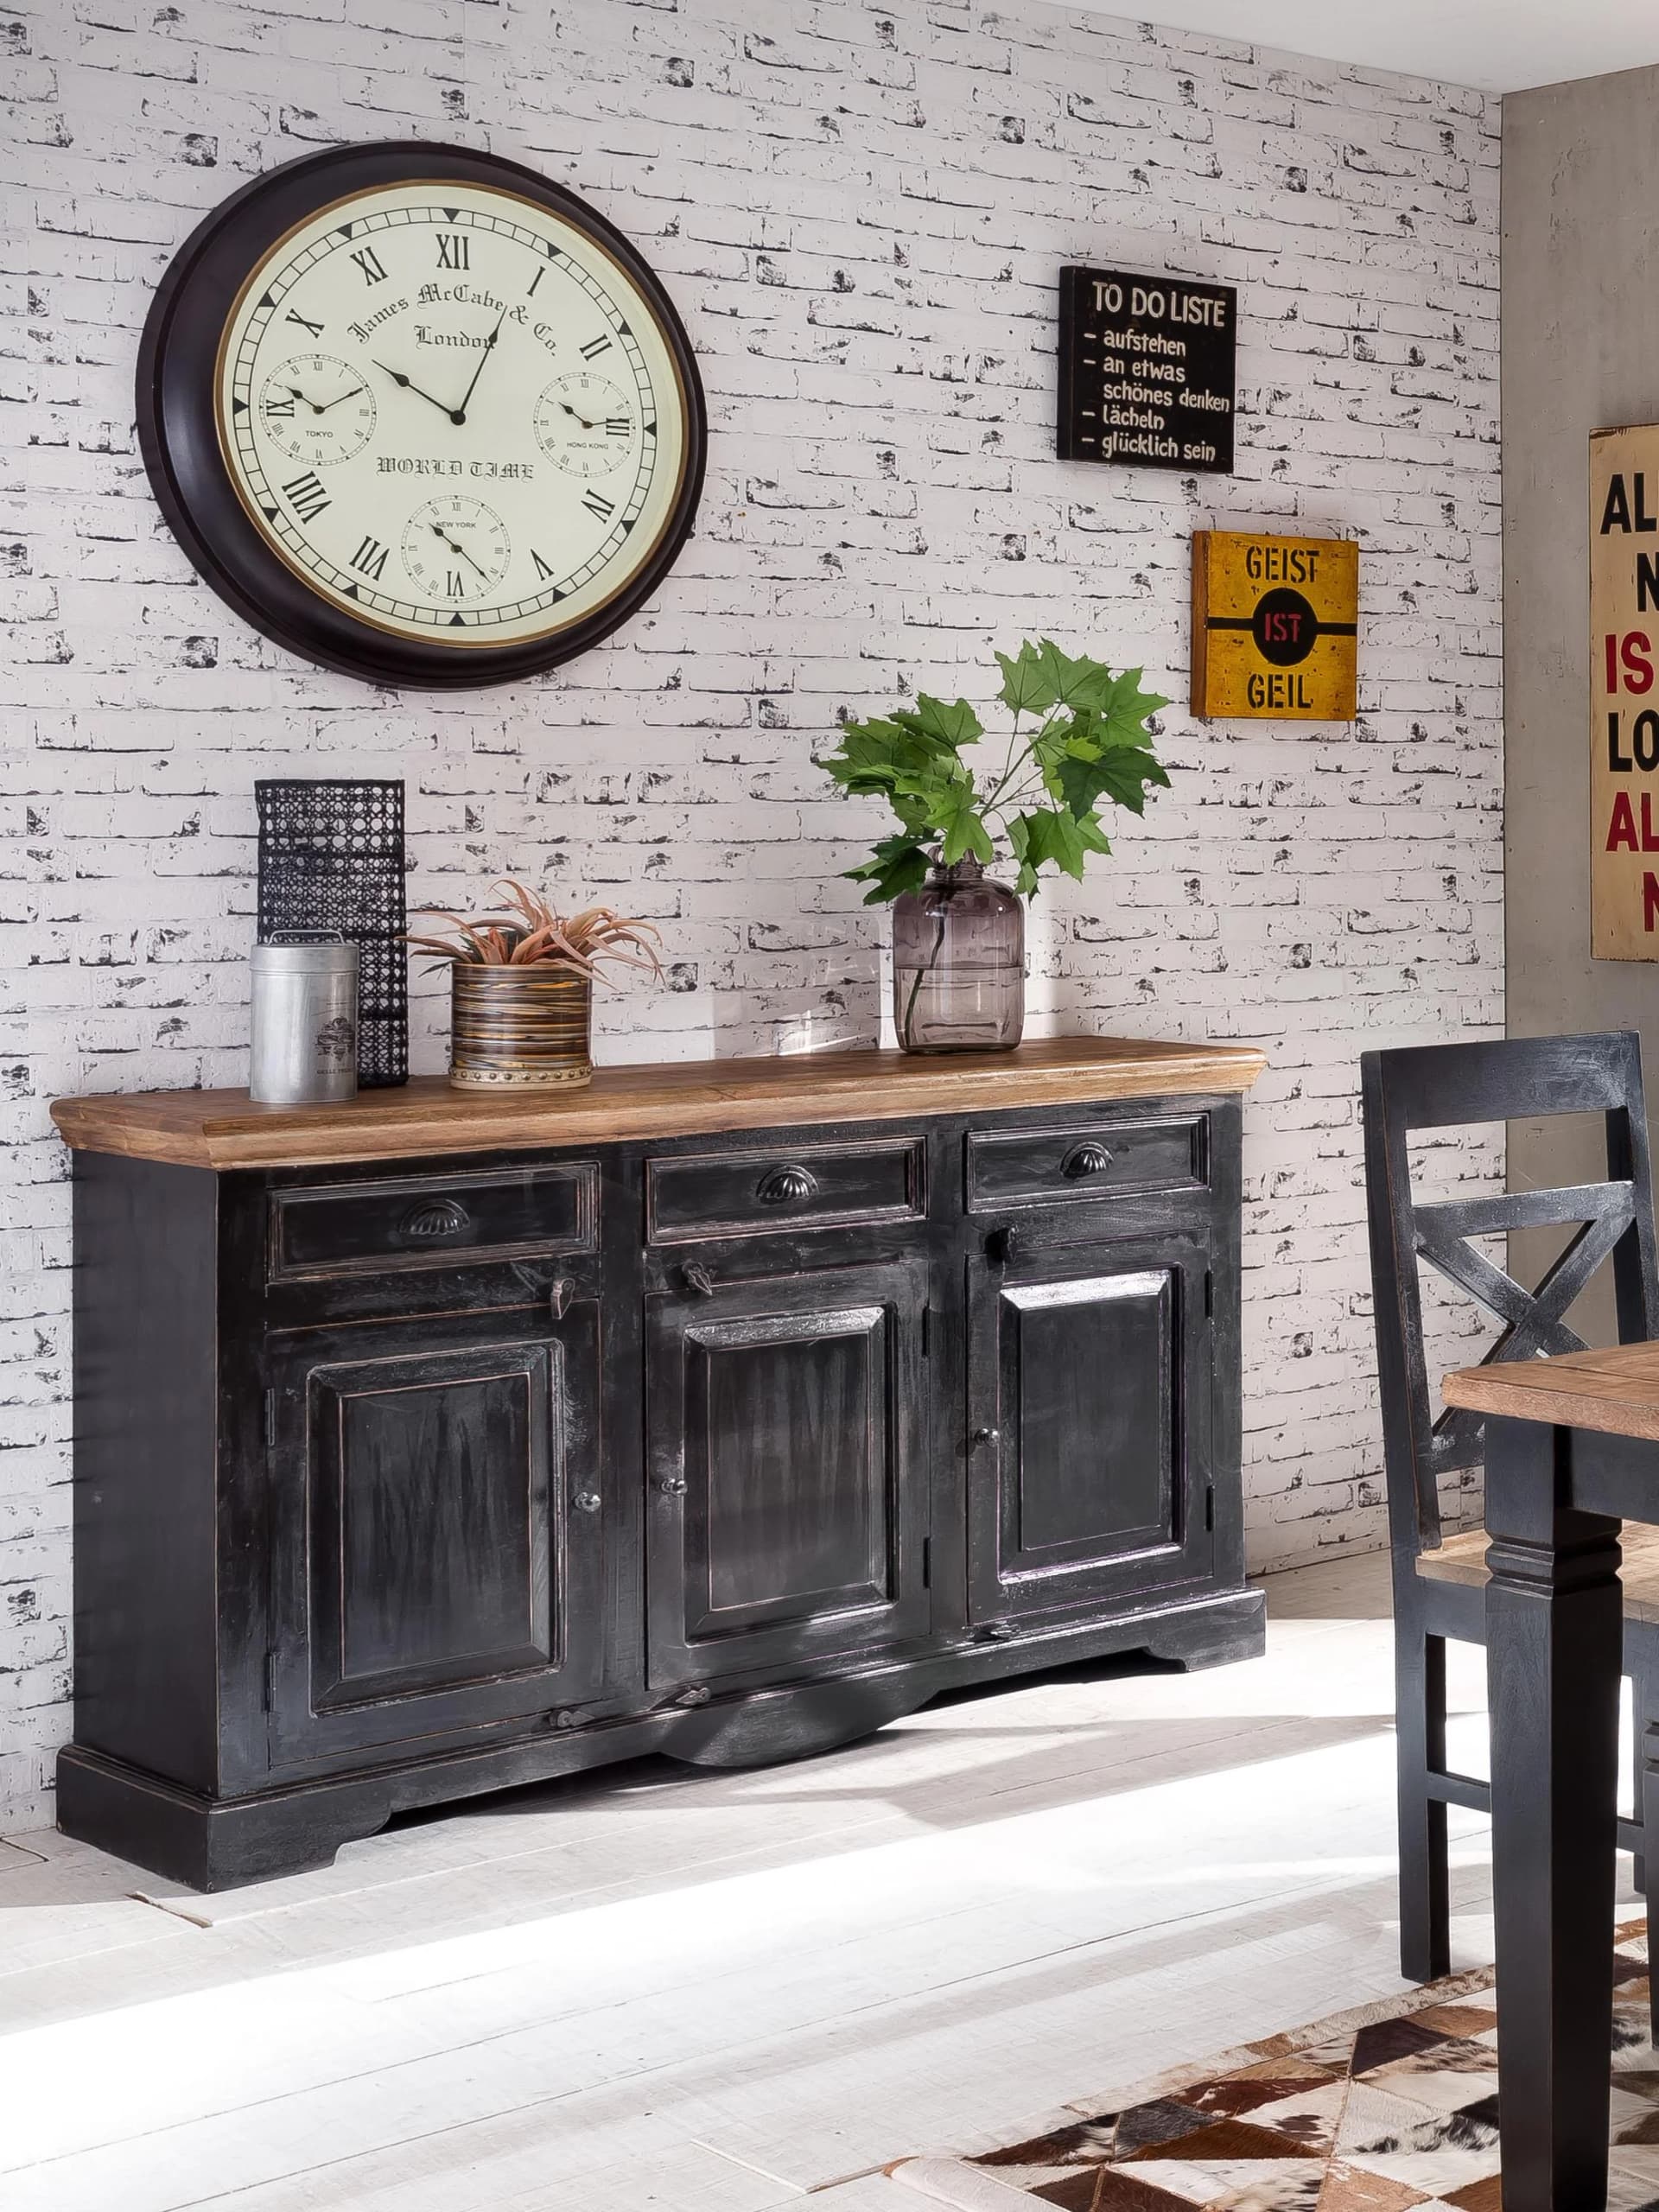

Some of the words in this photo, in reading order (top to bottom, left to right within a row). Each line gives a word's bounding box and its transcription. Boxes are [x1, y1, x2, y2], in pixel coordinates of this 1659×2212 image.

[349, 246, 389, 286] XI
[435, 233, 470, 270] XII
[526, 265, 546, 297] I
[346, 297, 409, 345] James
[416, 283, 504, 312] McCabe
[509, 305, 530, 325] &
[1092, 281, 1122, 312] TO
[1131, 287, 1165, 318] DO
[1171, 291, 1226, 327] LISTE
[285, 308, 325, 339] X
[579, 334, 613, 361] II
[1103, 328, 1186, 357] aufstehen
[1103, 356, 1125, 374] an
[1132, 359, 1185, 383] etwas
[266, 399, 295, 417] IX
[1103, 380, 1173, 407] schönes
[1179, 388, 1230, 412] denken
[606, 417, 630, 437] III
[1103, 404, 1165, 430] lächeln
[1102, 431, 1179, 459] glücklich
[1183, 441, 1216, 461] sein
[376, 456, 462, 480] WORLD
[470, 461, 534, 483] TIME
[281, 470, 333, 524] VIII
[581, 488, 615, 524] IV
[348, 535, 390, 582] VII
[530, 549, 554, 581] V
[1246, 545, 1320, 583] GEIST
[447, 570, 464, 596] VI
[1265, 613, 1301, 643] IST
[1605, 631, 1654, 695] IS
[1247, 673, 1312, 709] GEIL
[1608, 709, 1659, 772] LO
